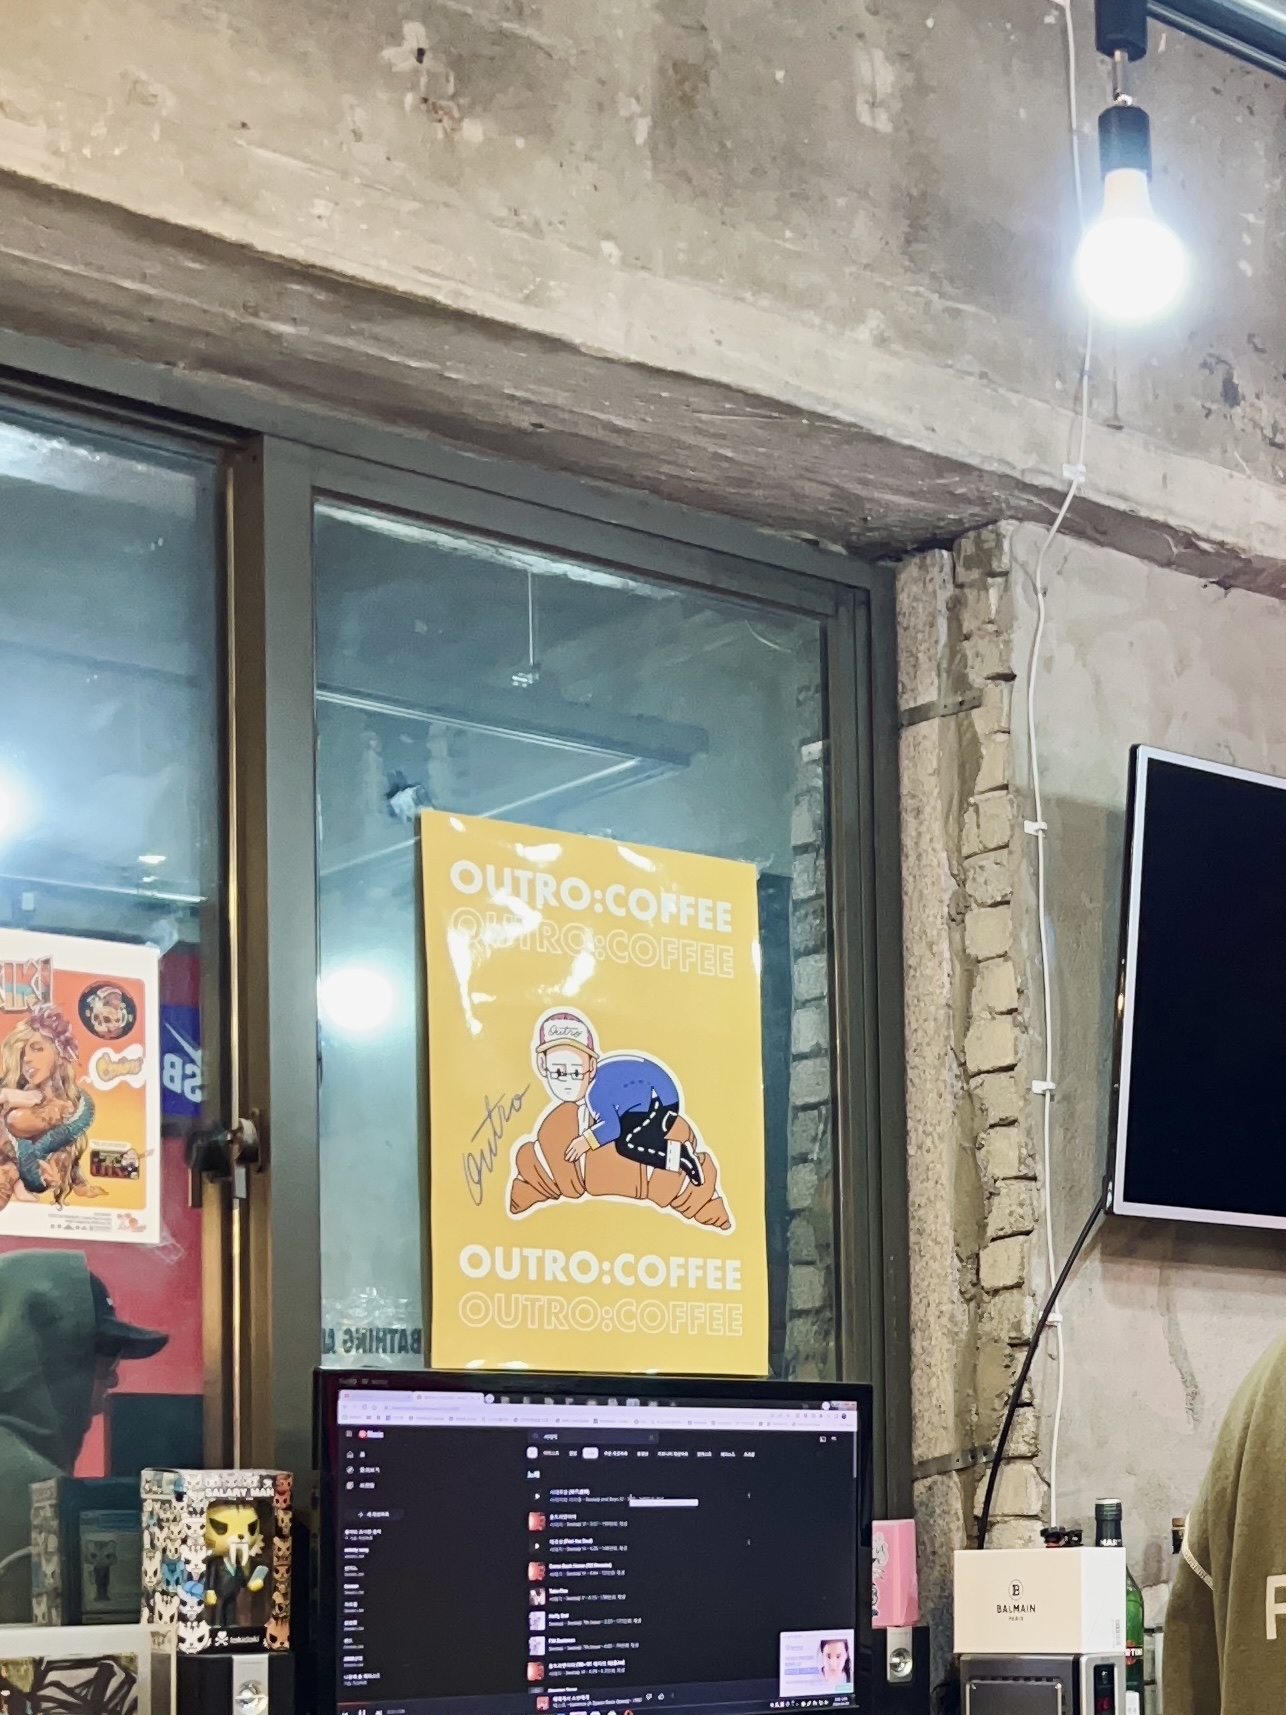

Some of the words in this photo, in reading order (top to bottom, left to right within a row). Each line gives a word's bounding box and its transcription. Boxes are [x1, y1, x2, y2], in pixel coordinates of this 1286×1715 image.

[450, 860, 733, 933] OUTRO:COFFEE
[459, 1244, 742, 1290] OUTRO:COFFEE
[459, 1291, 743, 1336] OUTRO:COFFEE
[205, 1488, 247, 1498] SALARY
[250, 1488, 275, 1498] MAN
[996, 1604, 1036, 1614] BALMAIN
